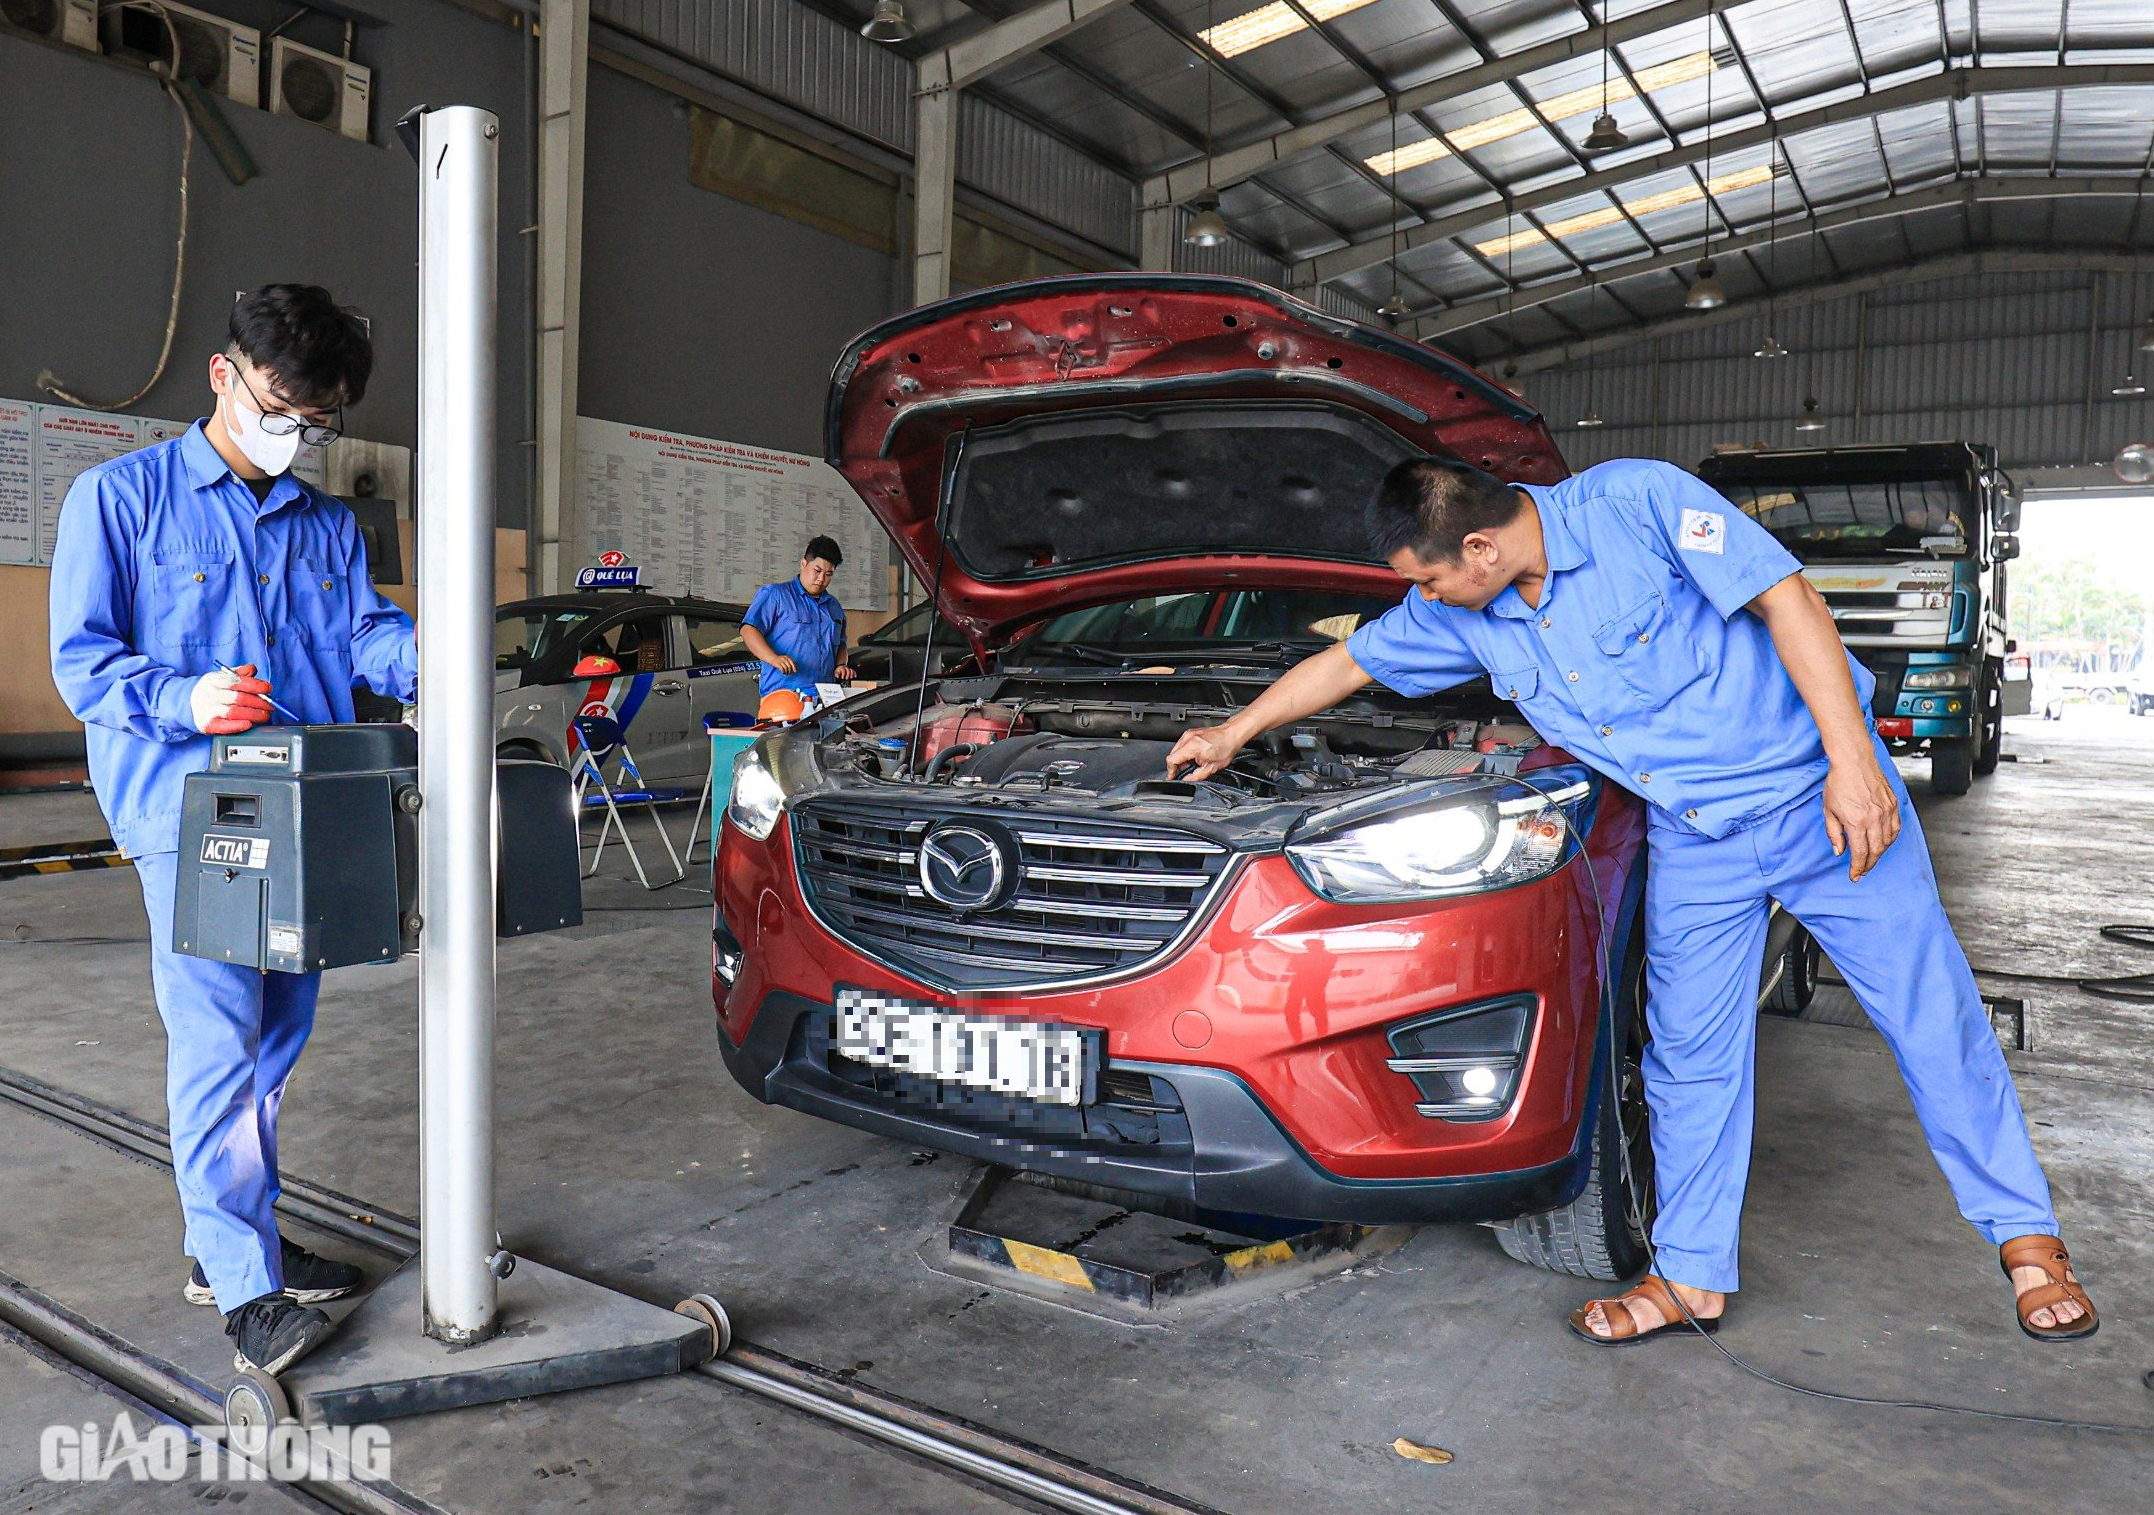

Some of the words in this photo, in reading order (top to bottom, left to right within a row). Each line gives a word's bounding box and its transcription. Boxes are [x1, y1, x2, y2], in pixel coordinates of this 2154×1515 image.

[629, 430, 640, 440] NỘI
[641, 432, 657, 441] DUNG
[686, 440, 708, 450] PHƯƠNG
[709, 443, 723, 452] PHÁP
[616, 571, 633, 582] LỤA
[746, 662, 761, 670] 33.5
